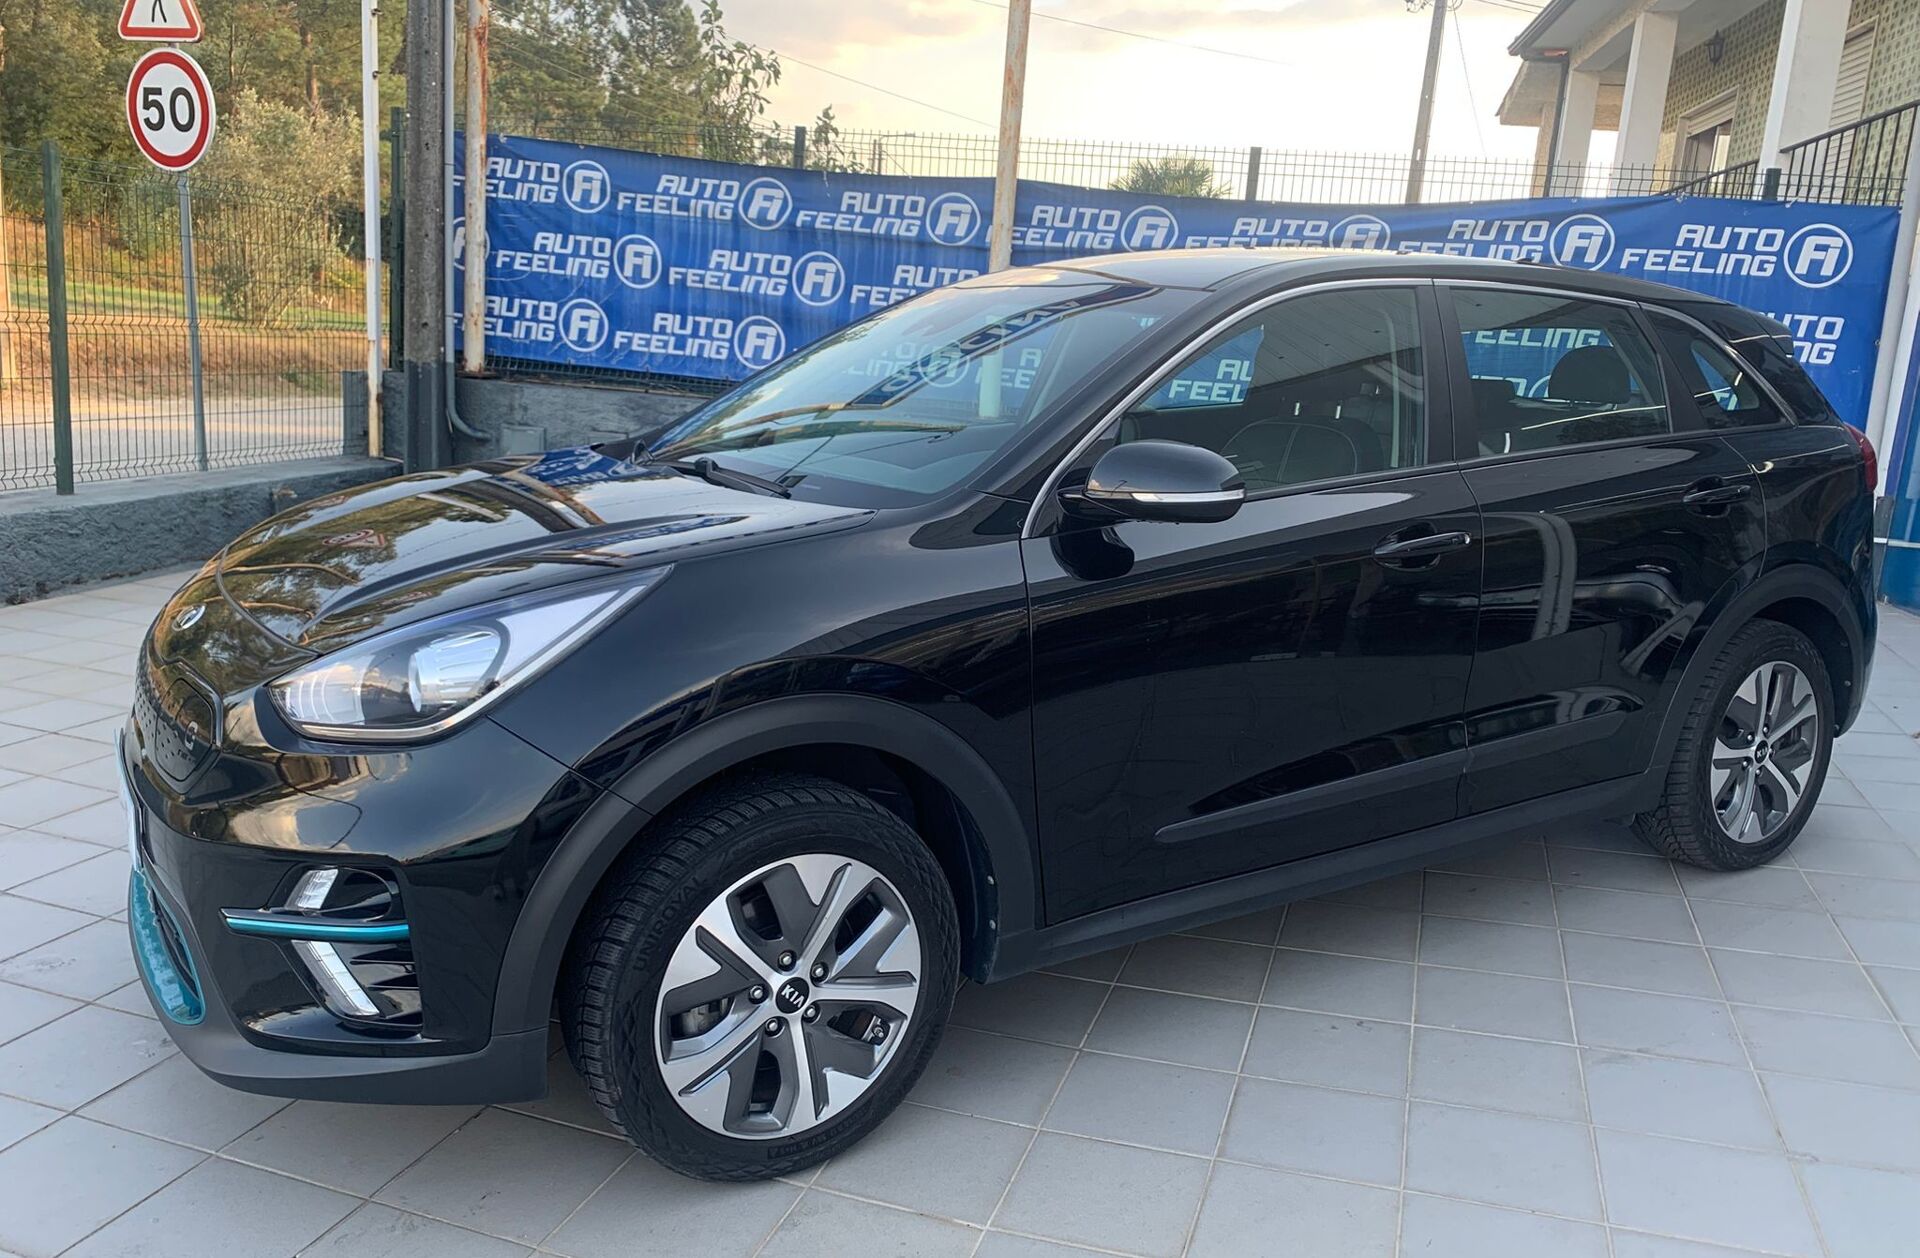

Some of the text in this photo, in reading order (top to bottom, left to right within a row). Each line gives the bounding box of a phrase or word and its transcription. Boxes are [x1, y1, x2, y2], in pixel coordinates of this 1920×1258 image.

[142, 86, 196, 133] 50
[486, 157, 560, 183] AUTO
[453, 175, 558, 203] ELING
[657, 174, 740, 201] AUTO
[617, 192, 734, 220] FEELING
[841, 191, 926, 217] AUTO
[796, 210, 921, 237] FEELING
[1031, 205, 1121, 231] AUTO
[1232, 217, 1329, 237] AUTO
[1447, 219, 1550, 242] AUTO
[534, 232, 612, 258] AUTO
[1675, 224, 1785, 252] AUTO
[496, 250, 611, 279] FEELING
[709, 249, 792, 276] AUTO
[1620, 248, 1777, 277] FEELING
[669, 267, 789, 296] FEELING
[485, 295, 558, 321] AUTO
[453, 312, 555, 341] ELING
[653, 312, 733, 339] AUTO
[1461, 328, 1601, 348] EELING
[614, 331, 730, 360] FEELING
[781, 984, 805, 1008] KIA
